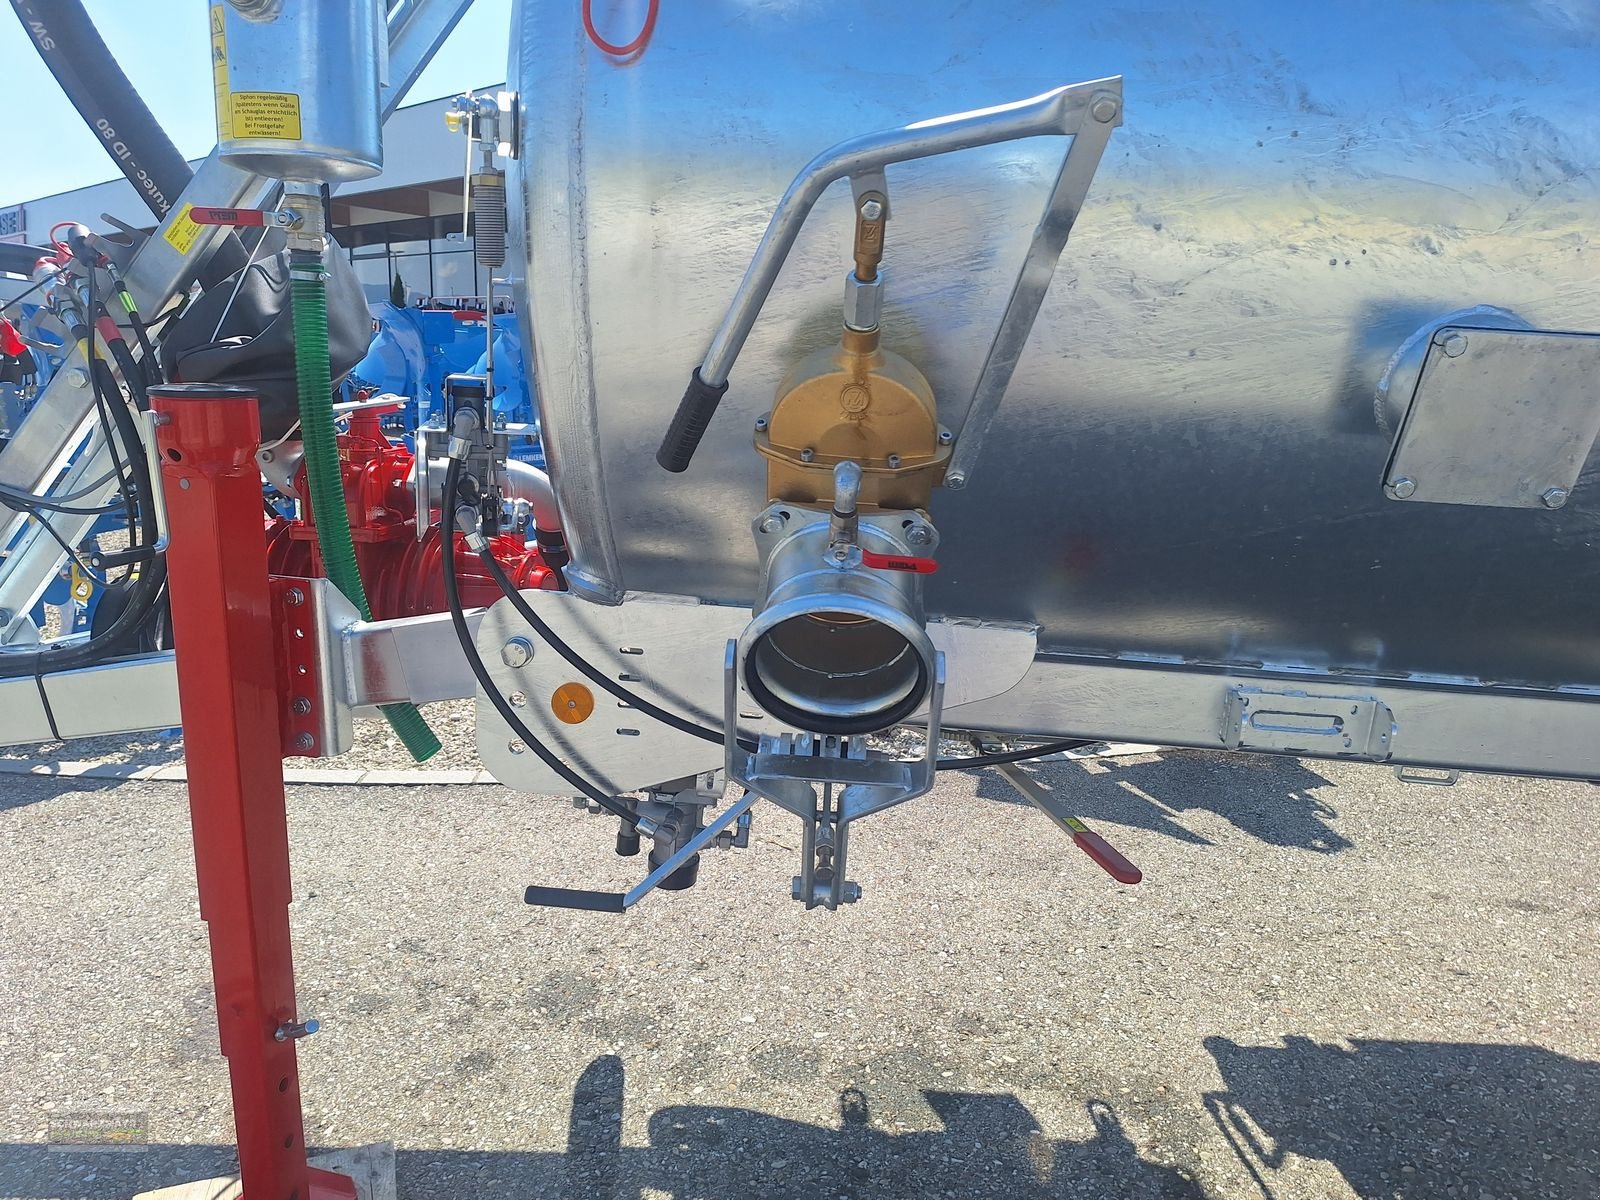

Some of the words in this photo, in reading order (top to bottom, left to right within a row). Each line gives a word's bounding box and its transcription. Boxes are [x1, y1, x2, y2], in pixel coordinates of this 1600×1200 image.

[257, 94, 288, 102] regelmäßig
[241, 108, 266, 116] Schauglas
[96, 118, 116, 140] 80
[113, 141, 132, 162] ID
[136, 170, 171, 213] kutec
[0, 211, 16, 236] SE
